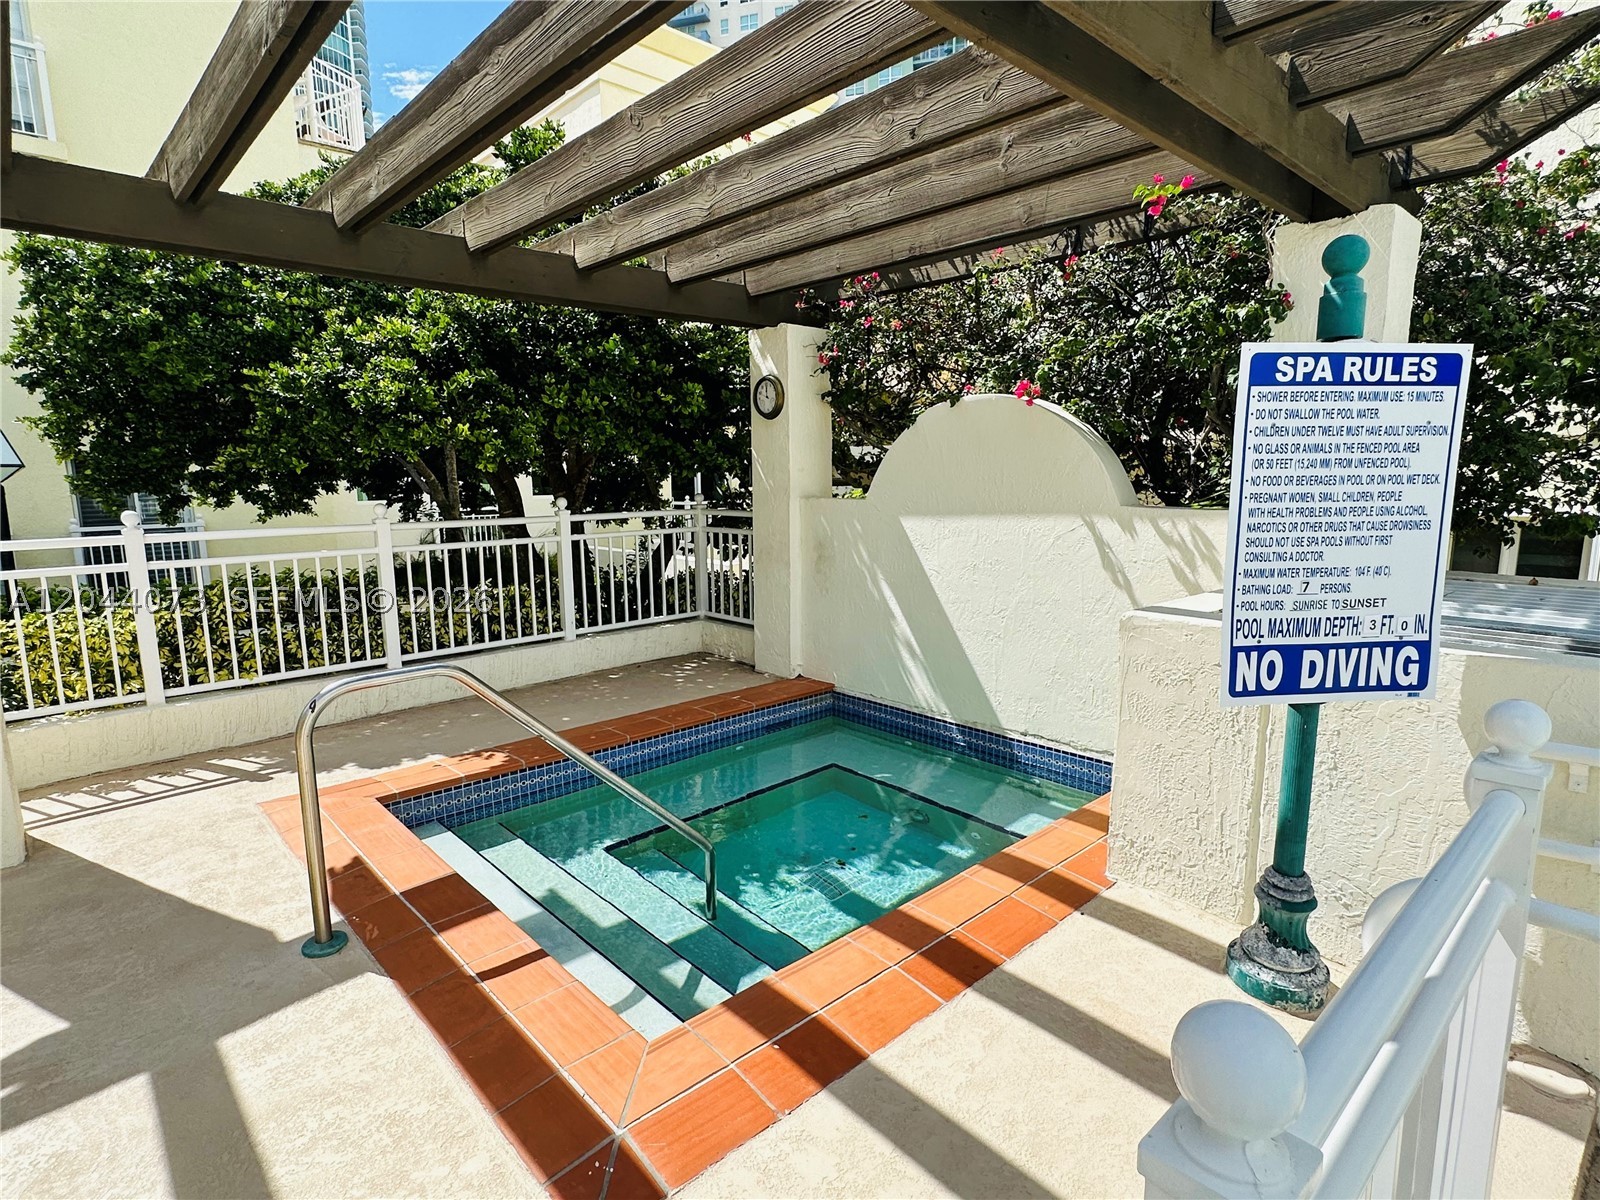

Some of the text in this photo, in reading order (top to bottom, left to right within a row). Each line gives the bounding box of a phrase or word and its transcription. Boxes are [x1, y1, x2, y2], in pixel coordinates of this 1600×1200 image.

[1276, 356, 1438, 382] SPA RULES
[1257, 391, 1288, 402] SHOWER
[1290, 391, 1318, 402] BEFORE
[1357, 391, 1389, 402] MAXIMUM
[1407, 391, 1414, 402] 15
[1256, 409, 1266, 419] DO
[1268, 409, 1283, 419] NOT
[1284, 409, 1320, 419] SWALLOW
[1322, 409, 1335, 419] THE
[1336, 409, 1354, 419] POOL
[1254, 425, 1449, 437] CHILDREN UNDER TWELVE MUST HAVE ADULT SUPERVISION.
[1253, 443, 1420, 454] NO GLASS OR ANIMALS IN THE FENCED POOL AREA
[1252, 458, 1264, 472] (OR
[1266, 459, 1274, 469] 50
[1276, 459, 1293, 469] FEET
[1319, 458, 1332, 471] MM)
[1334, 458, 1353, 468] FROM
[1354, 458, 1388, 468] UNFENCED
[1250, 476, 1260, 486] NO
[1262, 476, 1282, 486] FOOD
[1284, 475, 1294, 486] OR
[1296, 475, 1337, 486] BEVERAGES
[1338, 475, 1345, 485] IN
[1347, 475, 1364, 485] POOL
[1366, 475, 1375, 485] OR
[1377, 474, 1386, 485] ON
[1387, 474, 1404, 485] POOL
[1407, 474, 1421, 484] WET
[1249, 492, 1287, 503] PREGNANT
[1288, 492, 1316, 504] WOMEN,
[1318, 492, 1340, 502] SMALL
[1377, 491, 1402, 501] PEOPLE
[1248, 508, 1265, 518] WITH
[1267, 508, 1294, 518] HEALTH
[1295, 507, 1332, 518] PROBLEMS
[1333, 507, 1347, 517] AND
[1349, 506, 1374, 516] PEOPLE
[1375, 506, 1394, 516] USING
[1247, 520, 1431, 533] NARCOTICS OR OTHER DRUGS THAT CAUSE DROWSINESS
[1246, 535, 1393, 548] SHOULD NOT USE SPA POOLS WITHOUT FIRST
[1245, 552, 1287, 562] CONSULTING
[1289, 552, 1293, 562] A
[1243, 568, 1275, 578] MAXIMUM
[1277, 568, 1300, 578] WATER
[1242, 585, 1270, 595] BATHING
[1272, 584, 1293, 594] LOAD:
[1302, 582, 1310, 592] 7
[1241, 601, 1258, 611] POOL
[1293, 600, 1328, 610] SUNRISE
[1332, 600, 1340, 609] TO
[1342, 598, 1387, 608] SUNSET
[1236, 618, 1264, 639] POOL
[1268, 617, 1321, 638] MAXIMUM
[1324, 616, 1362, 637] DEPTH:
[1370, 620, 1376, 630] 3
[1380, 615, 1394, 635] FT.
[1414, 614, 1427, 634] IN.
[1235, 646, 1420, 692] NO DIVING
